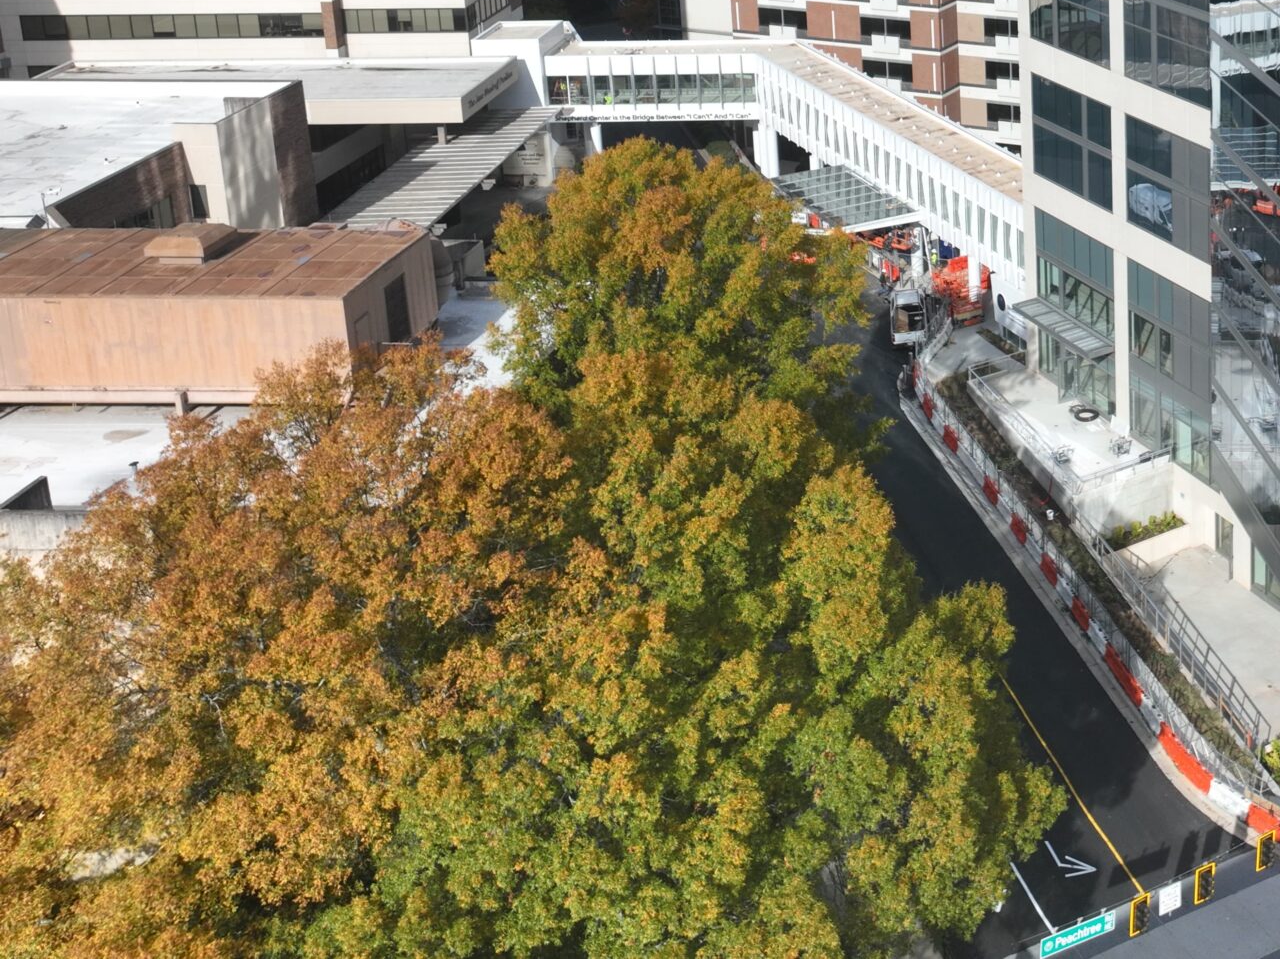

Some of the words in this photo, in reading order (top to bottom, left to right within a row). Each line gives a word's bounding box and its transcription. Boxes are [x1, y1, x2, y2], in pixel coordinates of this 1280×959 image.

[555, 114, 587, 122] Shepherd
[632, 114, 655, 122] Bridge
[1054, 922, 1103, 949] Peachtree
